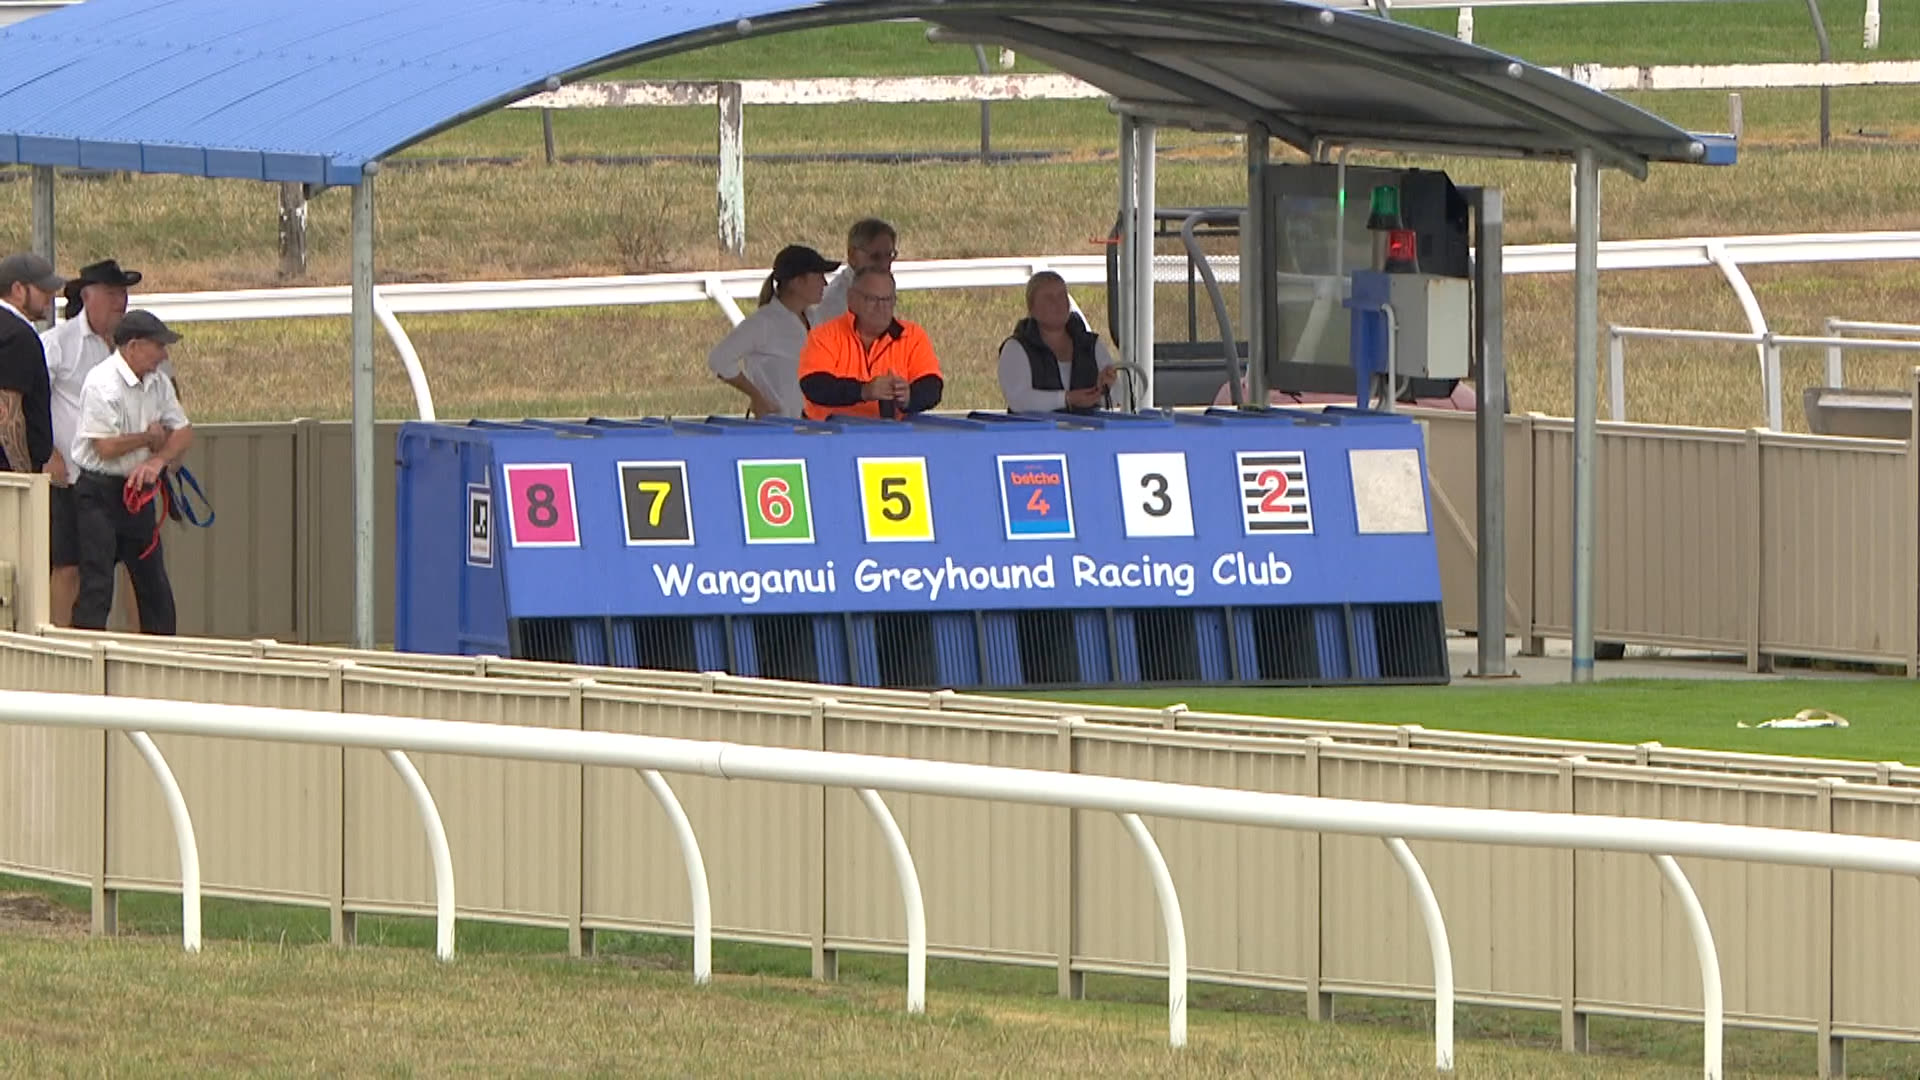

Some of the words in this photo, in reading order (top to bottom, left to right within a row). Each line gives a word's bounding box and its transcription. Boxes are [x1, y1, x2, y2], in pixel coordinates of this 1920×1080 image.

[880, 477, 912, 521] 5
[1011, 471, 1060, 486] betcha
[1140, 472, 1172, 517] 3
[1257, 469, 1291, 514] 2
[526, 483, 559, 528] 8
[637, 481, 671, 527] 7
[757, 477, 793, 526] 6
[1027, 488, 1050, 516] 4
[653, 560, 836, 603] Wanganui
[854, 555, 1056, 600] Greyhound
[1073, 554, 1196, 597] Racing
[1212, 551, 1292, 586] Club
